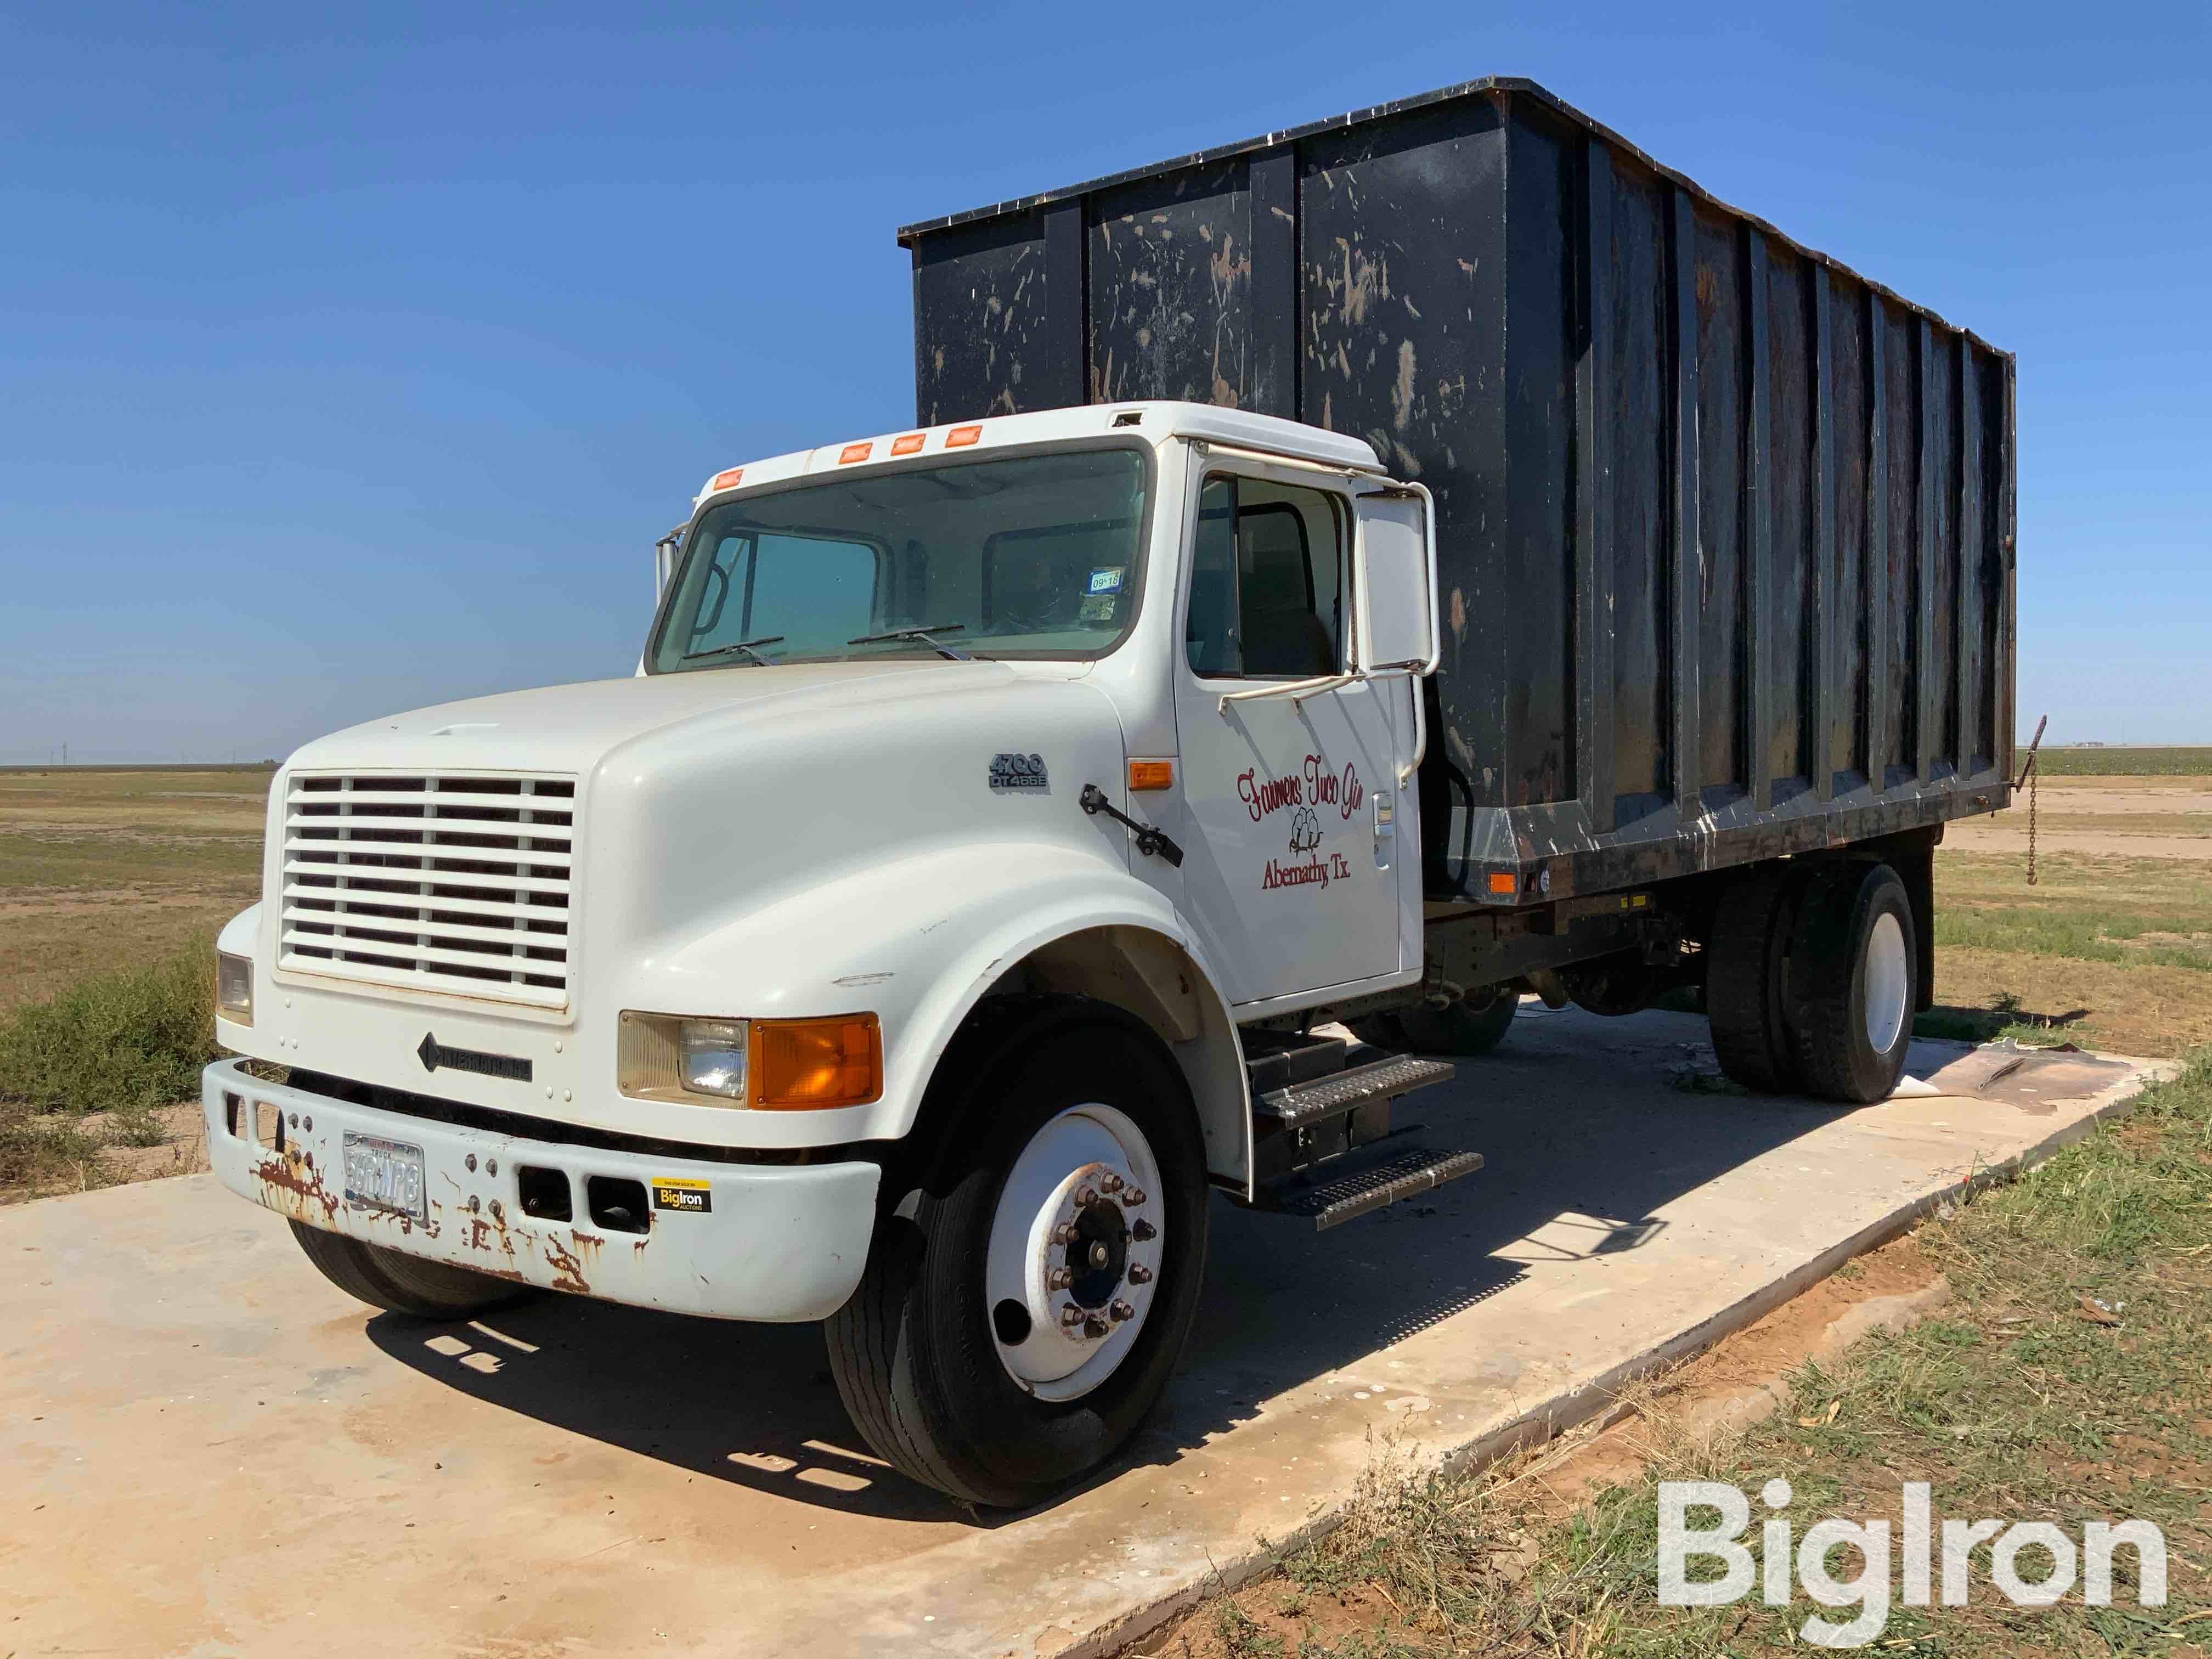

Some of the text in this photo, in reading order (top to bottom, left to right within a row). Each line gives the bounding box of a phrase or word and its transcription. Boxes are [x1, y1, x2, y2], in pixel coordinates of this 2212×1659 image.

[1093, 575, 1118, 589] 09 18
[989, 753, 1044, 772] 4700
[1237, 766, 1302, 822] Farmers
[1341, 761, 1363, 820] Gin
[371, 1148, 391, 1160] TRUCK
[660, 1189, 703, 1207] BigIron
